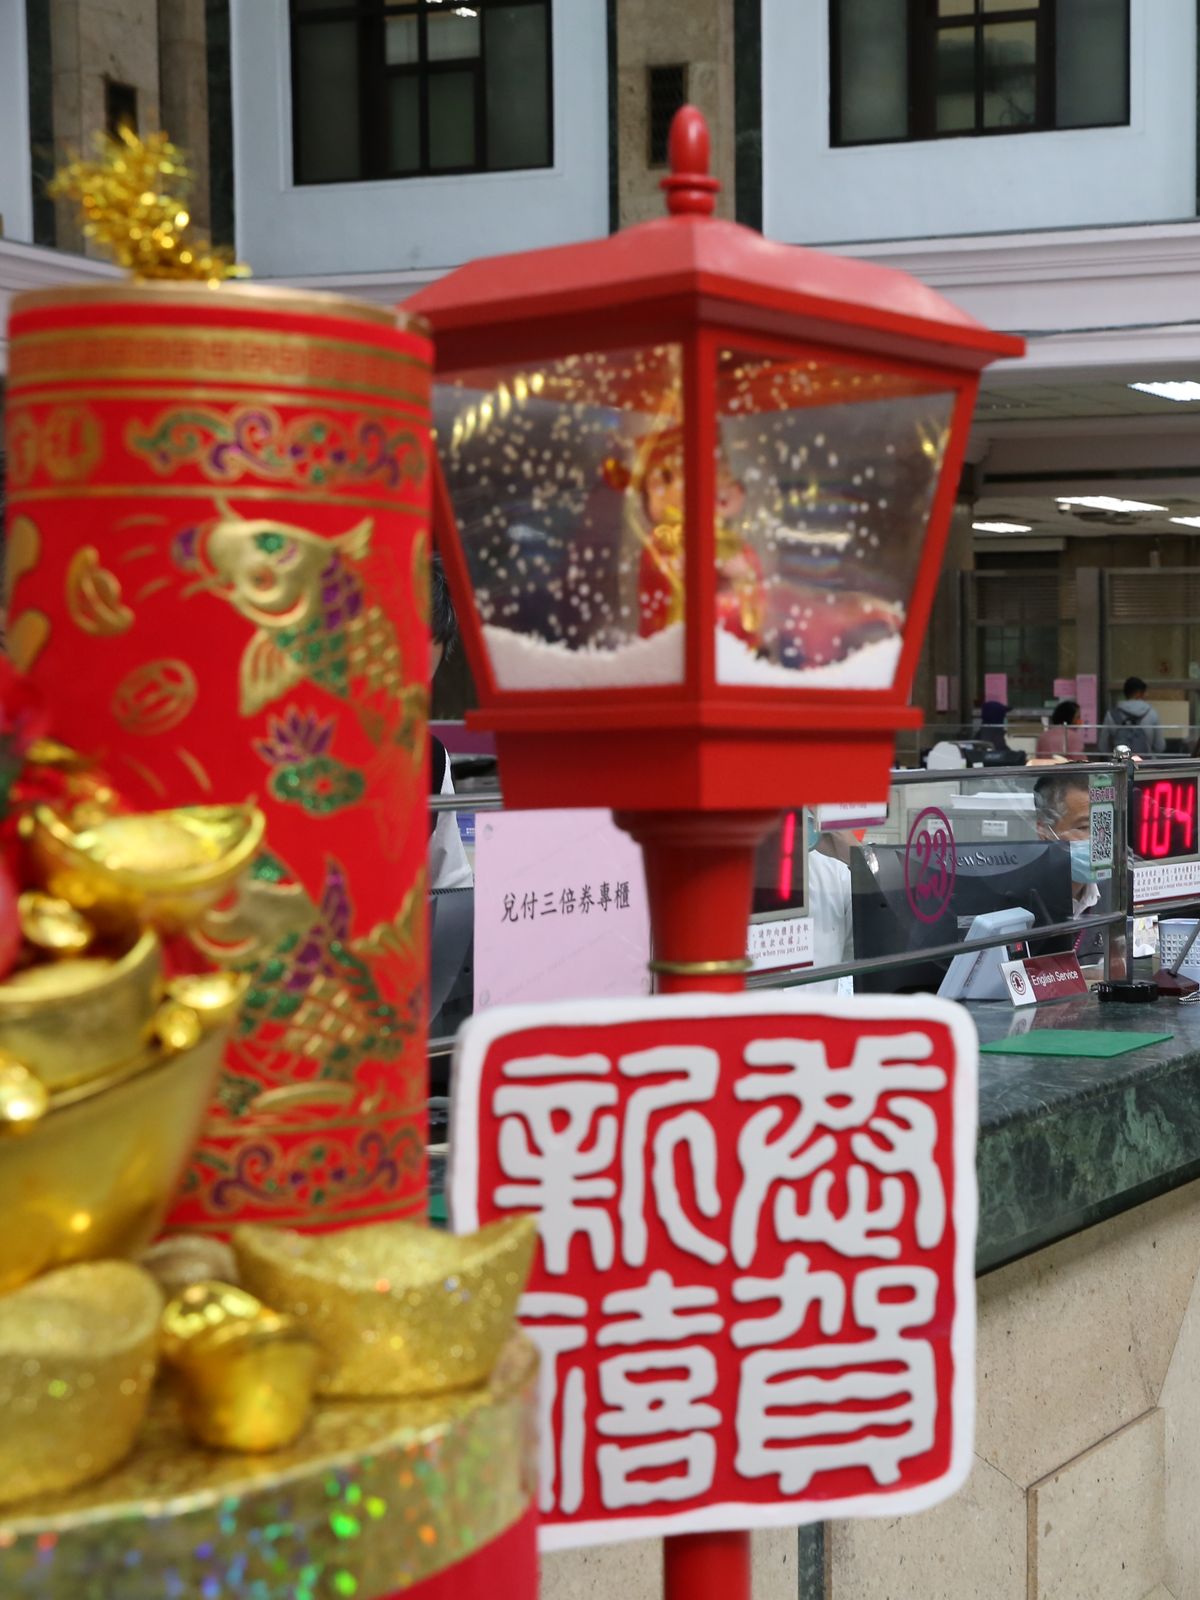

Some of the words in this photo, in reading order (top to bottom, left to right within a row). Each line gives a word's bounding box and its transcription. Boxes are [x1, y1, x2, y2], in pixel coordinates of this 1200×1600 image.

[1141, 781, 1195, 857] 104
[916, 829, 948, 901] 23
[501, 880, 631, 923] 兌付三倍券專櫃
[1030, 973, 1056, 987] English
[1055, 969, 1079, 982] Service
